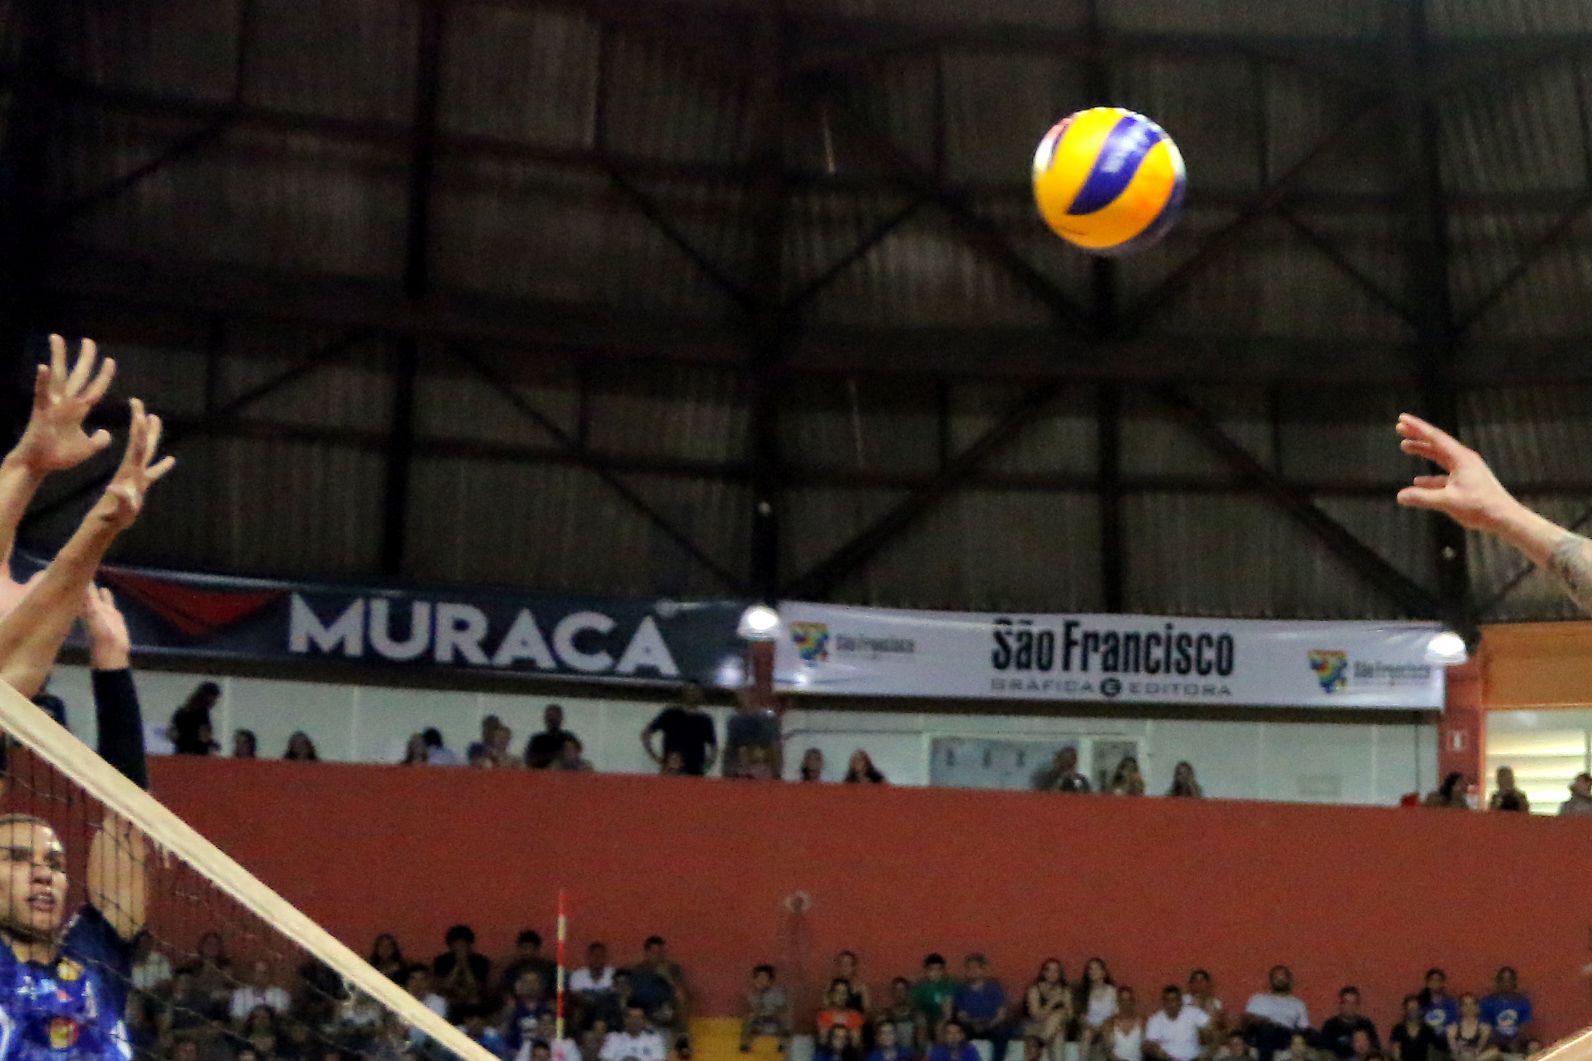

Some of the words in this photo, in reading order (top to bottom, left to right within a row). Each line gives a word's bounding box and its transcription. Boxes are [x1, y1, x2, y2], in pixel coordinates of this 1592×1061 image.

[288, 592, 681, 677] MURACA
[991, 617, 1055, 671] São
[1062, 620, 1234, 676] Francisco
[1129, 681, 1232, 697] EDITORA
